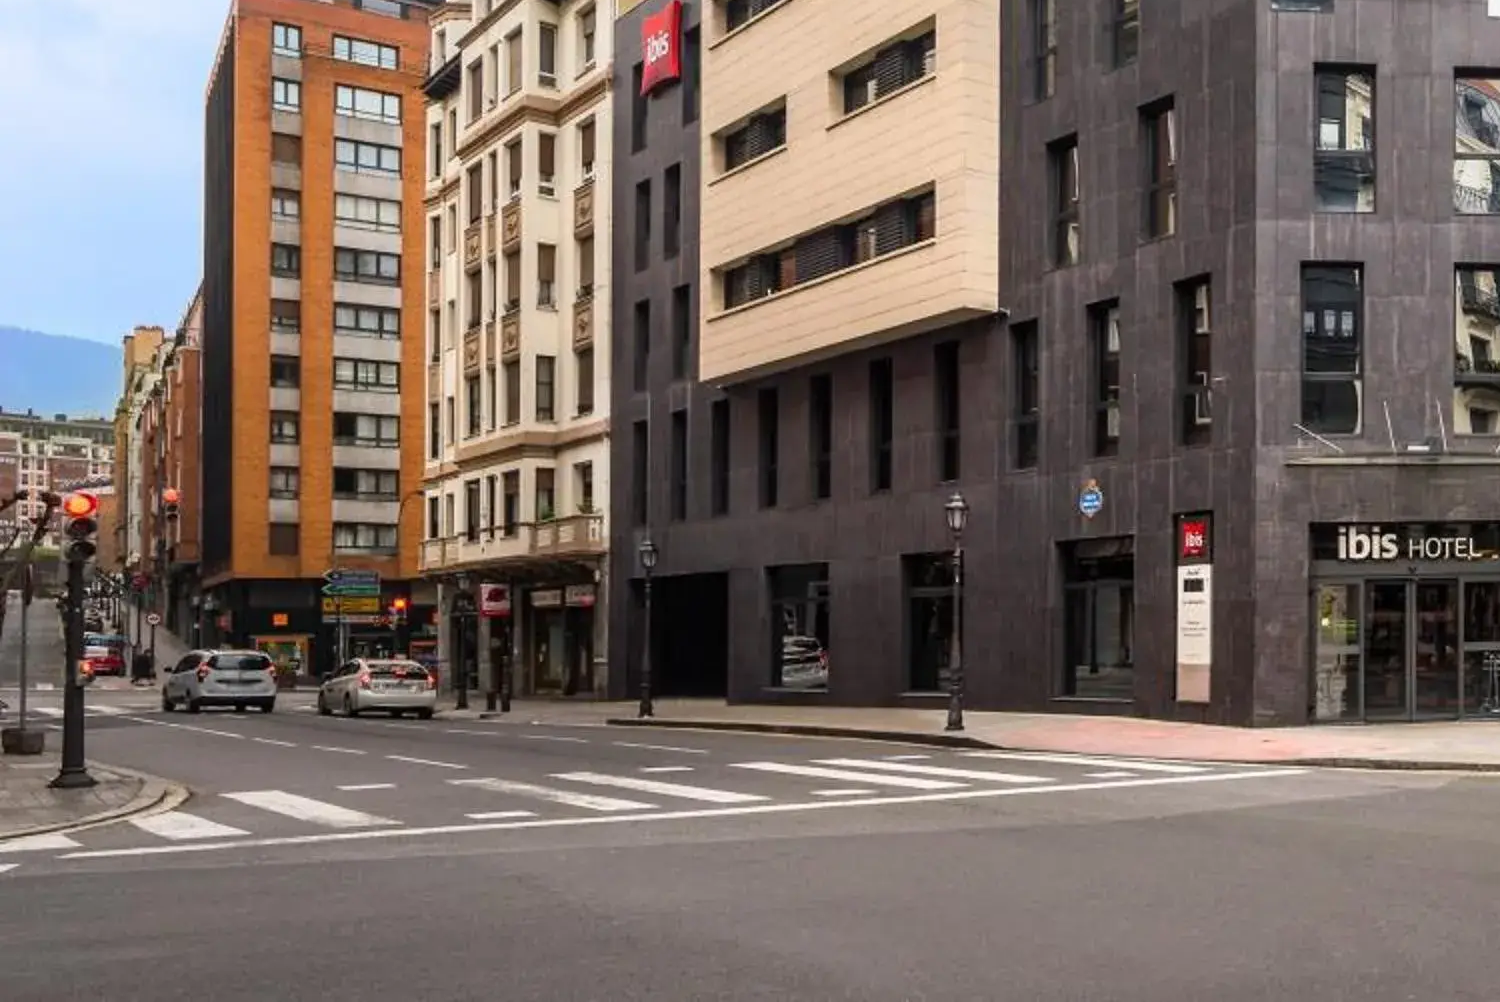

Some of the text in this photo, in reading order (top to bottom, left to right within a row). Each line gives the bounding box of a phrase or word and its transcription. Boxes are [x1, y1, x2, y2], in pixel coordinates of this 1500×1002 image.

[647, 30, 670, 66] ibis
[1185, 531, 1203, 547] ibis
[1338, 526, 1483, 560] ibis HOTEL
